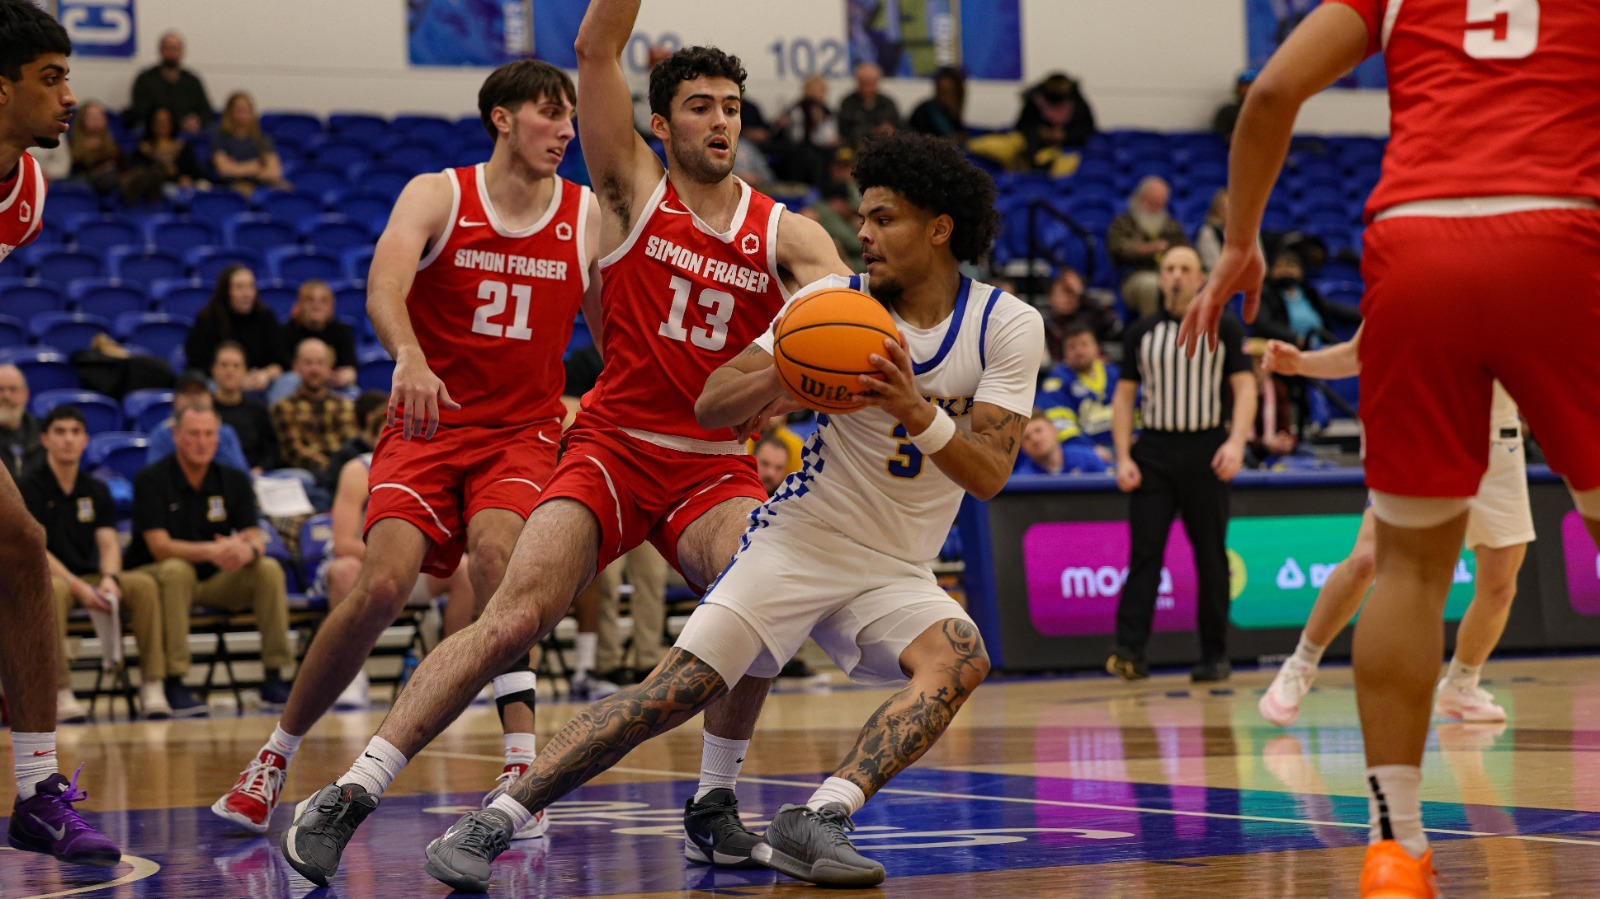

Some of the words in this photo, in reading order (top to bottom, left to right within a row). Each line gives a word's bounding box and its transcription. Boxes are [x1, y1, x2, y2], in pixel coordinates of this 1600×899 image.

[769, 38, 848, 79] 102
[1463, 0, 1540, 59] 5
[454, 248, 505, 273] SIMON
[507, 254, 568, 281] FRASER
[644, 235, 704, 274] SIMON
[703, 257, 769, 293] FRASER
[471, 279, 533, 341] 21
[658, 275, 735, 351] 13
[885, 420, 926, 481] 3
